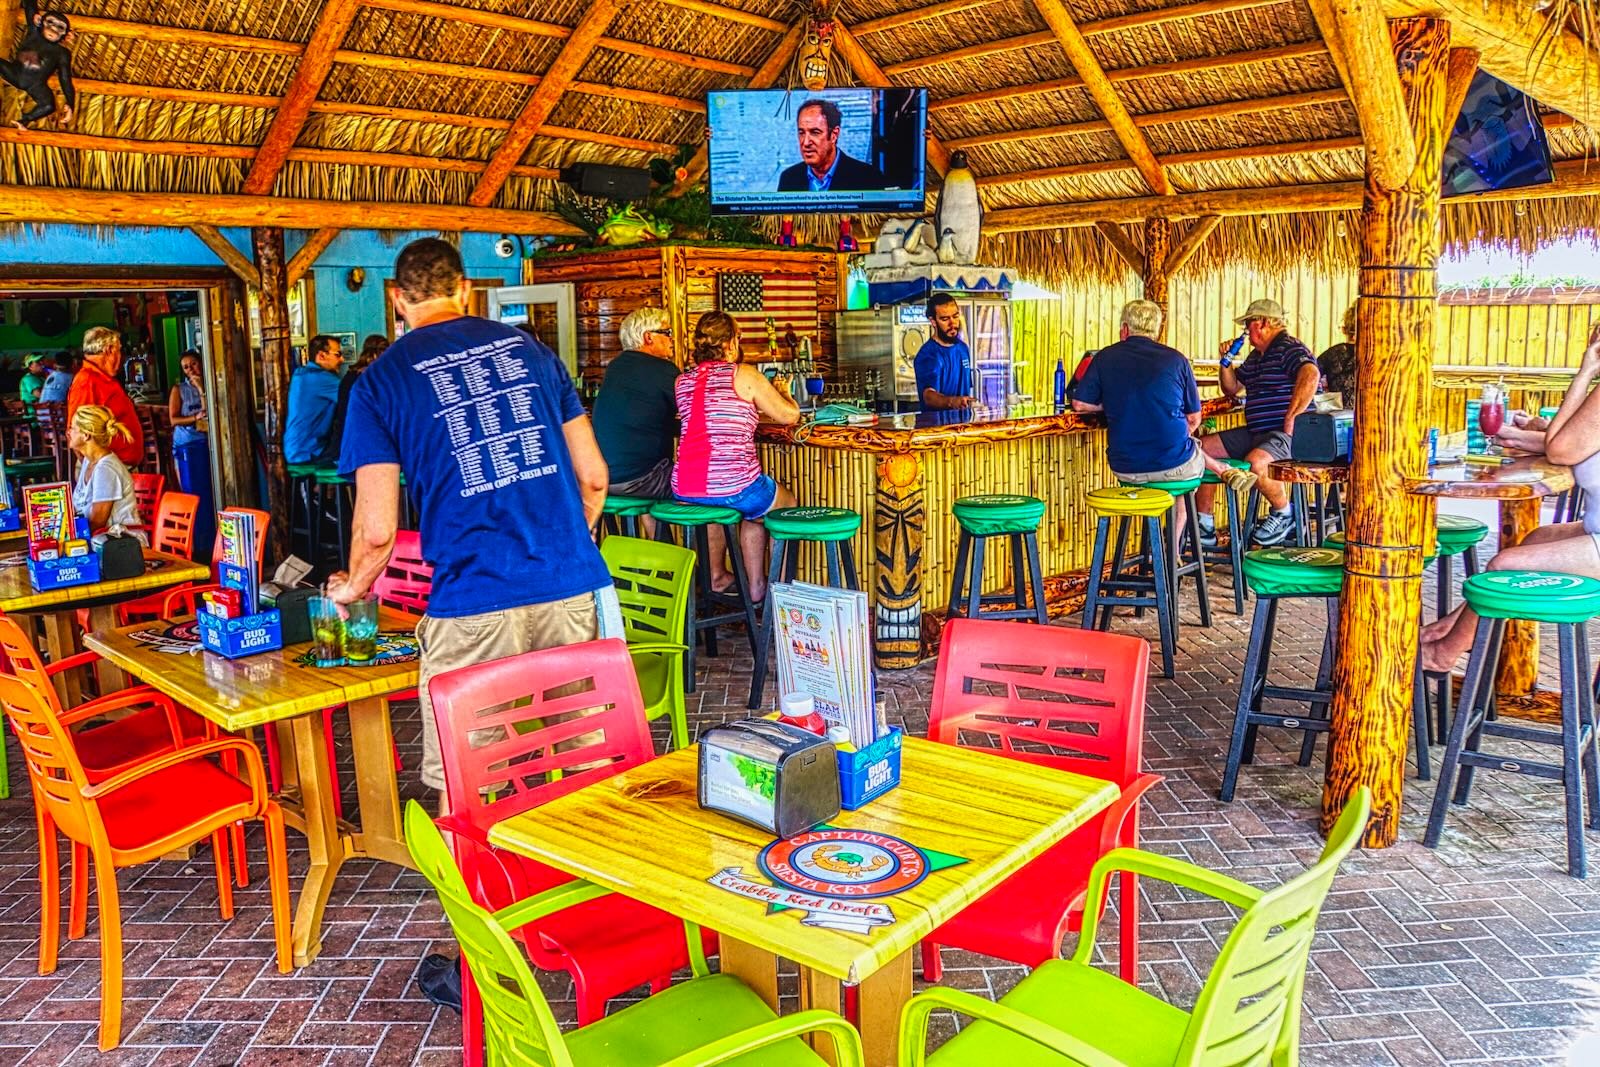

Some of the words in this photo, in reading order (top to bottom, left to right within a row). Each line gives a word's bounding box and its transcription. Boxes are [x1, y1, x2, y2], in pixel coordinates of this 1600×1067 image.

[460, 482, 494, 497] CAPTAIN
[519, 468, 542, 481] SIESTA
[541, 464, 557, 475] KEY
[56, 572, 82, 582] LIGHT
[58, 567, 78, 576] BUD
[240, 634, 271, 649] LIGHT
[243, 628, 266, 640] BUD
[868, 758, 888, 779] BUD
[864, 766, 892, 792] LIGHT
[790, 831, 882, 846] CAPTAIN
[771, 862, 819, 893] SIESTA
[825, 885, 873, 895] KEY
[720, 876, 781, 901] Crabby
[785, 894, 822, 908] Red
[828, 901, 884, 915] Draft
